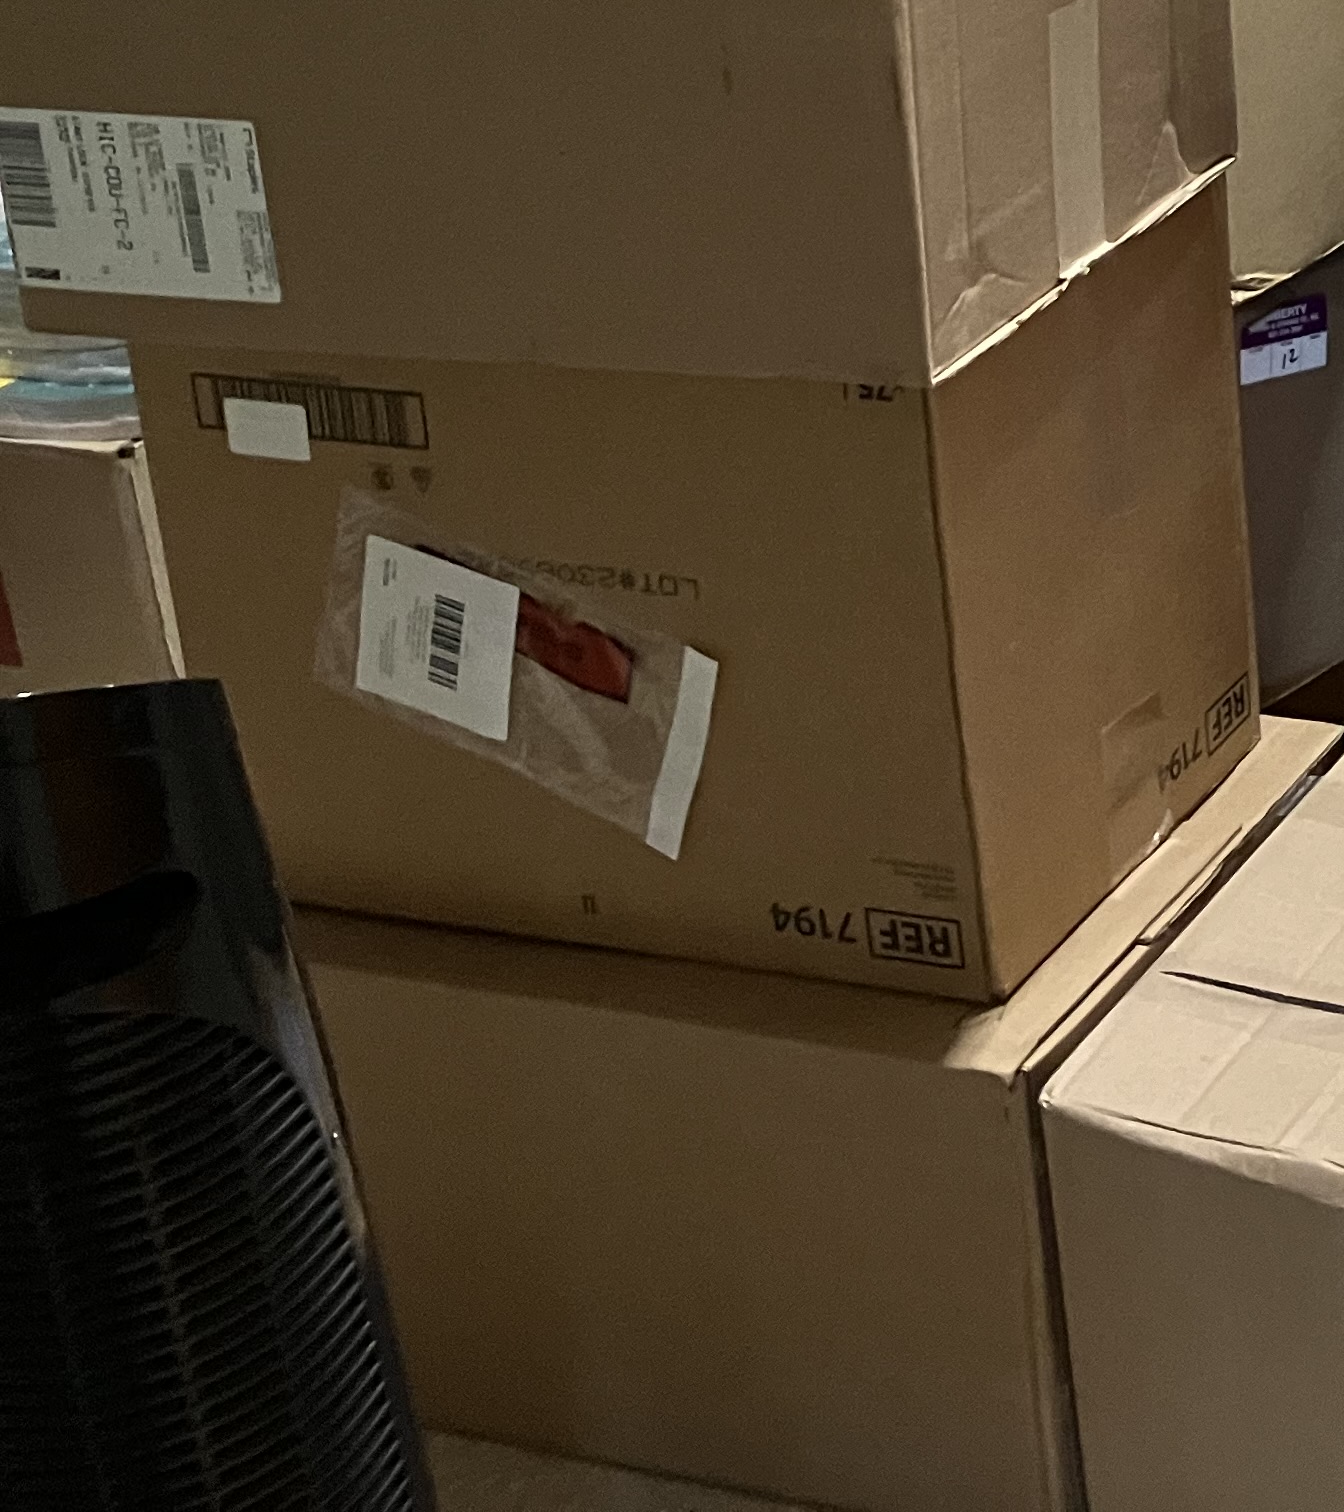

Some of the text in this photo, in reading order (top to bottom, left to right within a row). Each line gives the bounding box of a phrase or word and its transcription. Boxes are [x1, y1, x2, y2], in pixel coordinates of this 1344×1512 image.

[1281, 348, 1300, 370] 12
[1211, 682, 1248, 742] REF
[770, 902, 951, 958] REF 7194
